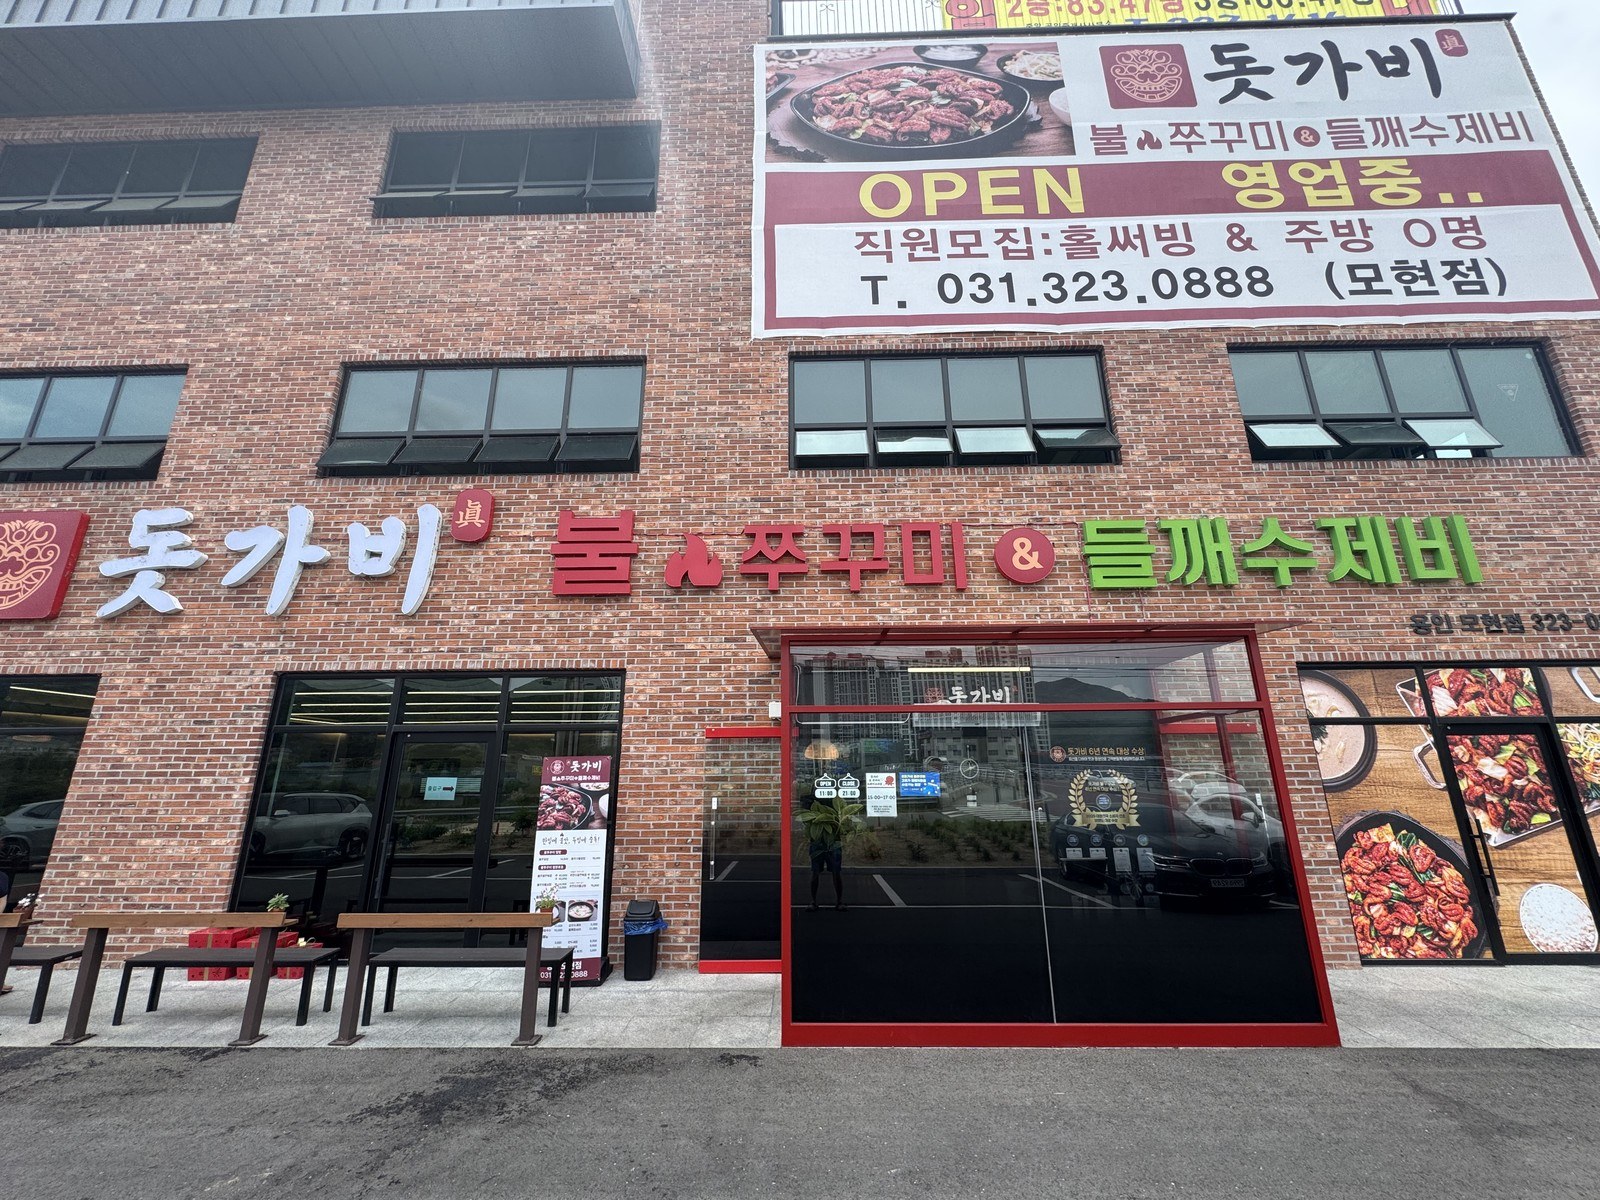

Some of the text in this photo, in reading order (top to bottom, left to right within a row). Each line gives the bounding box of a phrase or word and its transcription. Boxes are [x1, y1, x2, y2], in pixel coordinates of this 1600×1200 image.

[1203, 37, 1442, 105] 돗가비
[1089, 123, 1129, 156] 불
[1326, 111, 1534, 151] 들깨수제비
[859, 158, 1484, 218] OPEN 영업중..
[1225, 222, 1259, 251] &
[1284, 217, 1374, 254] 주방
[860, 257, 1507, 309] T. 031.323.0888 (모현점)
[96, 503, 443, 619] 돗가비
[551, 509, 639, 597] 불
[739, 521, 967, 594] 쭈꾸미
[1082, 514, 1485, 589] 들깨수제비
[1410, 612, 1600, 636] 용인 모현점 323-0
[570, 760, 601, 773] 돗가비
